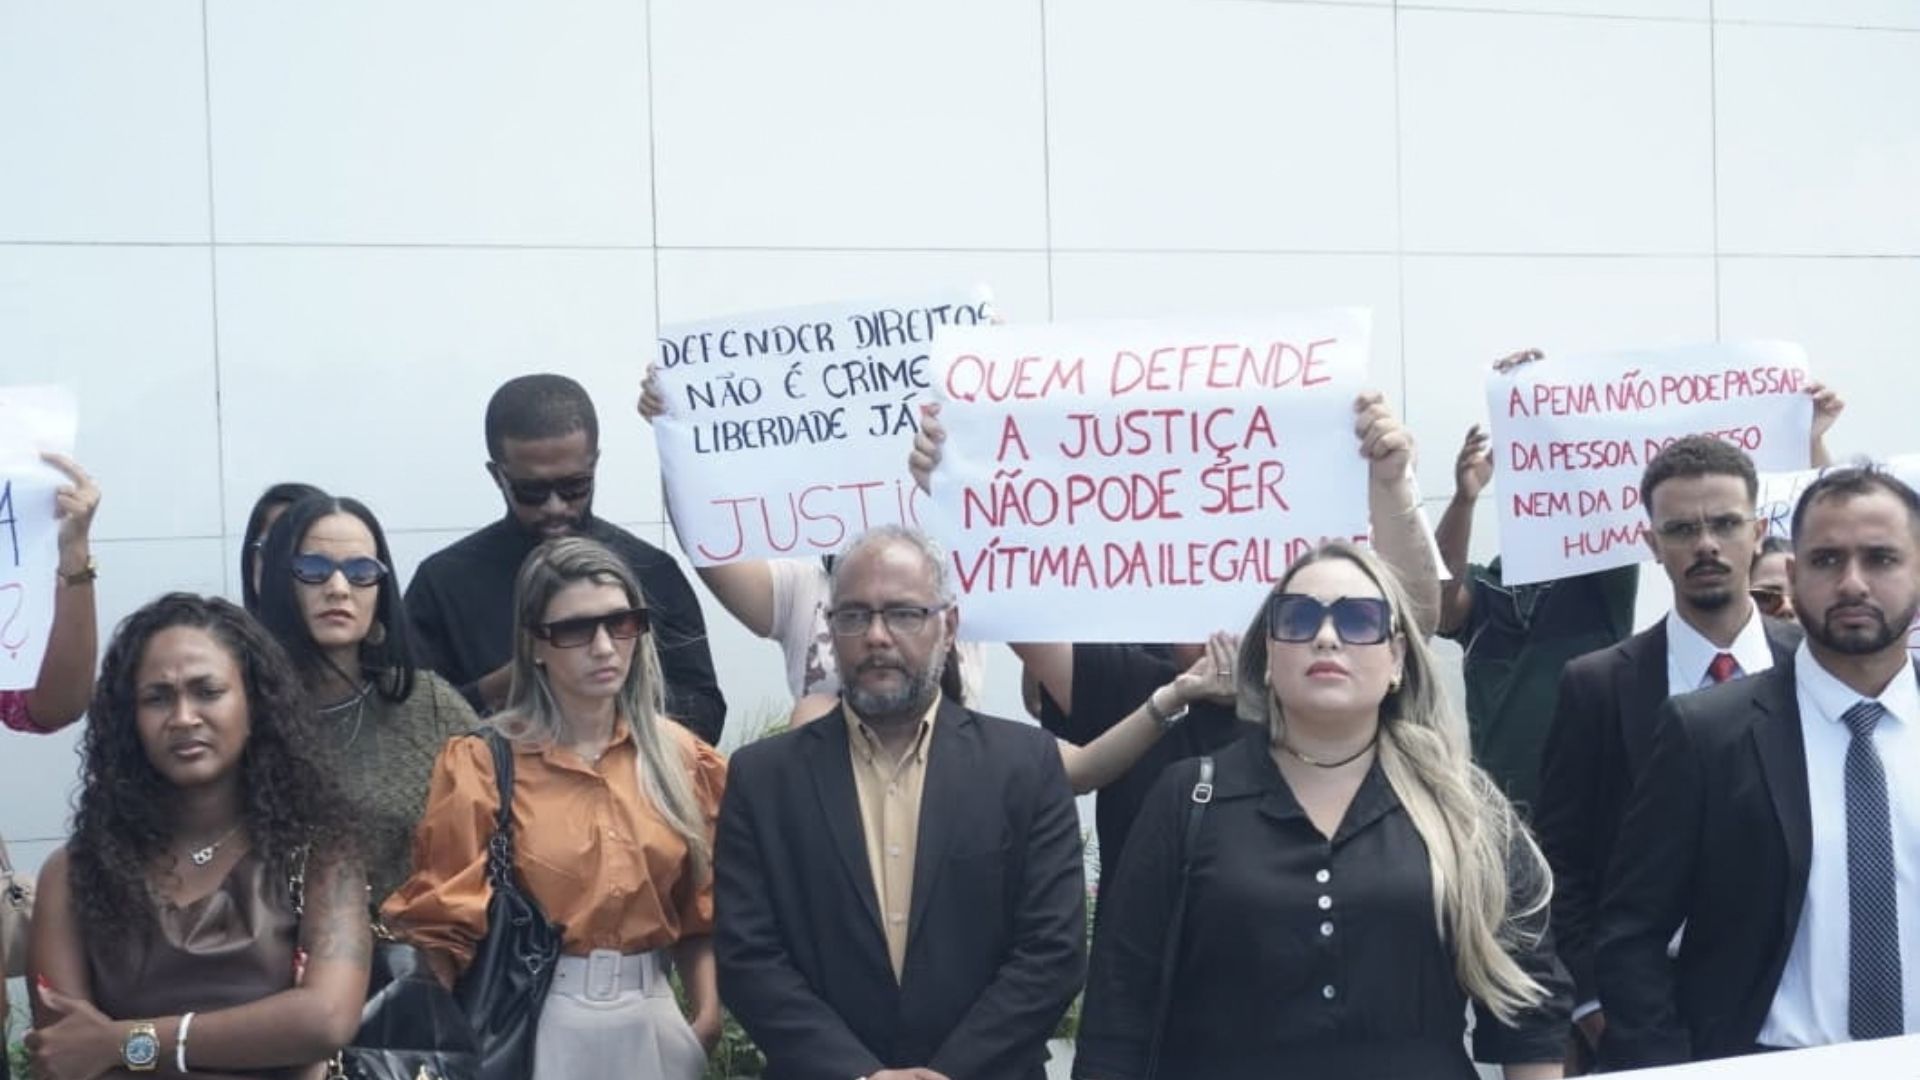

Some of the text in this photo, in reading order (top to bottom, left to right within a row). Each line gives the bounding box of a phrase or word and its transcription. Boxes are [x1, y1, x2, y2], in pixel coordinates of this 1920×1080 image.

[659, 322, 835, 368] DEFENDER
[946, 338, 1337, 402] QUEM DEFENDE
[686, 355, 930, 410] NÃO É CRIME
[1509, 386, 1530, 418] A
[1534, 382, 1600, 415] PENA
[1606, 369, 1656, 411] NÃO
[1661, 374, 1721, 405] PODE
[693, 392, 918, 454] LIBERDADE JÁ
[997, 405, 1278, 465] A JUSTIÇA
[1512, 441, 1544, 472] DA
[1549, 440, 1637, 470] PESSOA
[963, 461, 1289, 529] NÃO PODE SER
[1513, 491, 1571, 518] NEM
[1579, 489, 1612, 517] DA
[952, 537, 1098, 593] VÍTIMA
[1104, 540, 1152, 588] DA
[1564, 520, 1645, 558] HUMA
